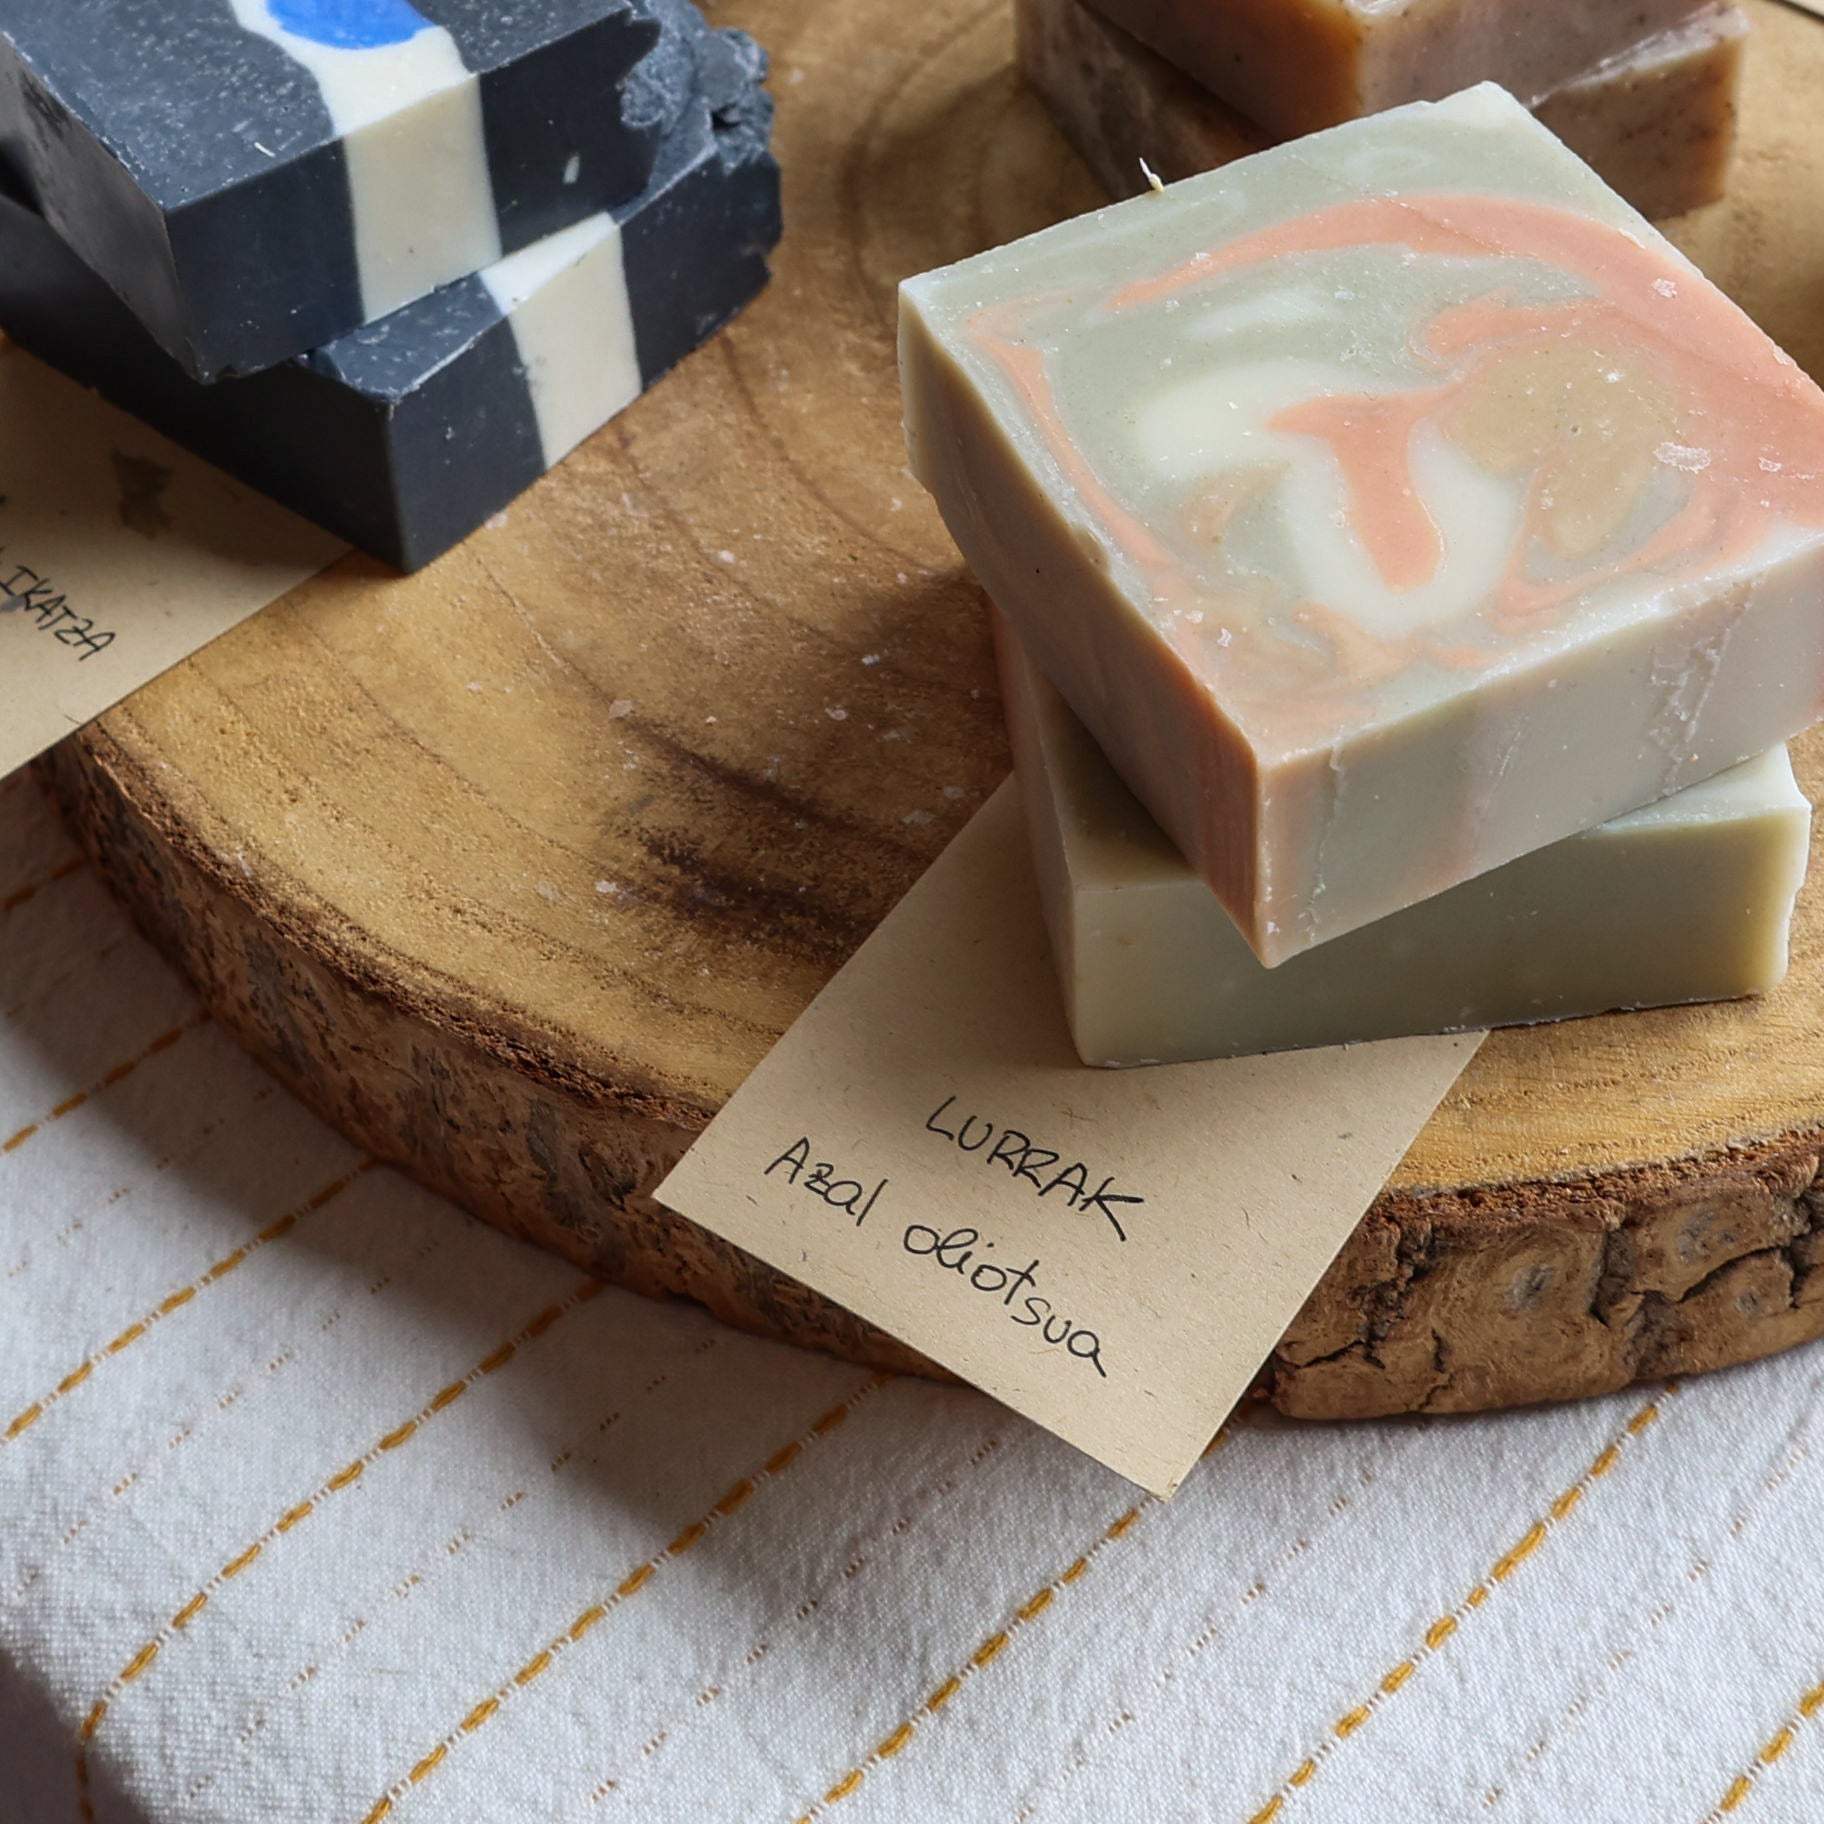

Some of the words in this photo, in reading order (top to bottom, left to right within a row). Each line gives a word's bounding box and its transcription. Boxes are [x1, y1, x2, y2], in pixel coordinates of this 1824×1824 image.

[762, 1136, 889, 1227] Azal
[902, 1224, 1109, 1378] oliotsua
[924, 1095, 1144, 1242] LURRAK
